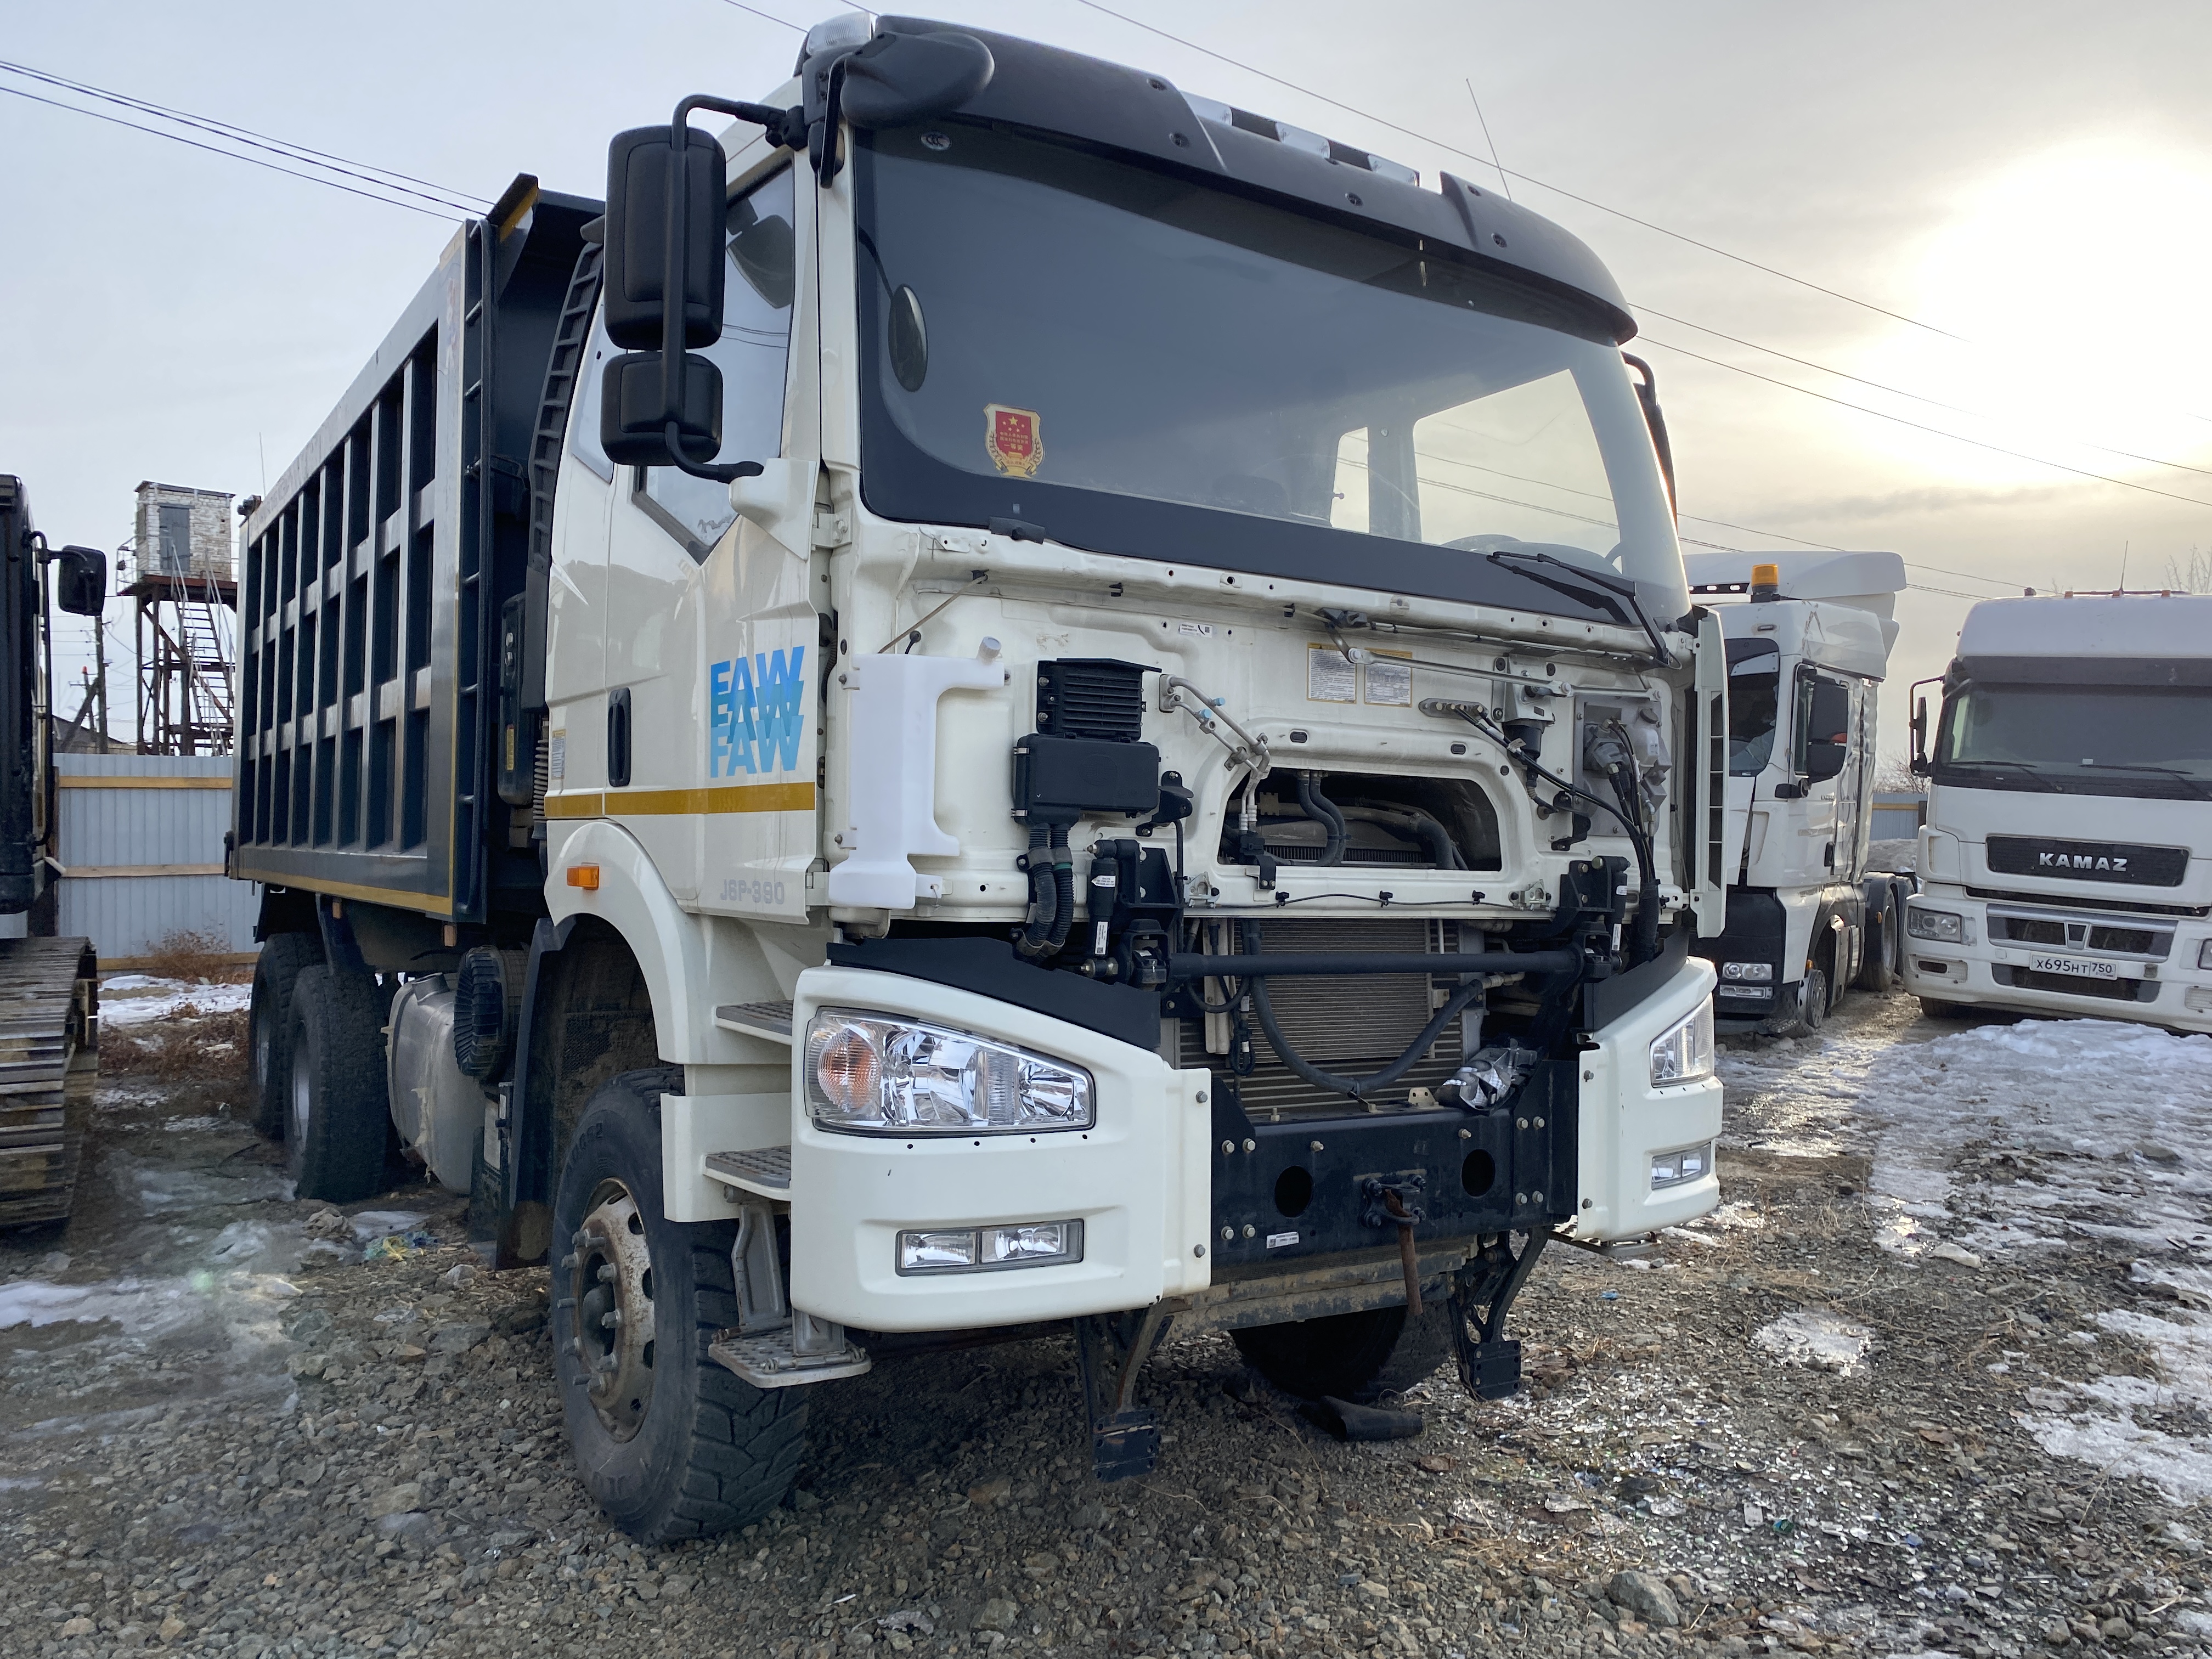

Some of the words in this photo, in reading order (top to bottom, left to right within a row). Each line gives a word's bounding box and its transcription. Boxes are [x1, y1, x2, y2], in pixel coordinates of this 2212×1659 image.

[710, 715, 804, 778] FAW
[2039, 853, 2128, 872] KAMAZ
[720, 879, 785, 905] J6P-390
[2092, 963, 2112, 973] 750
